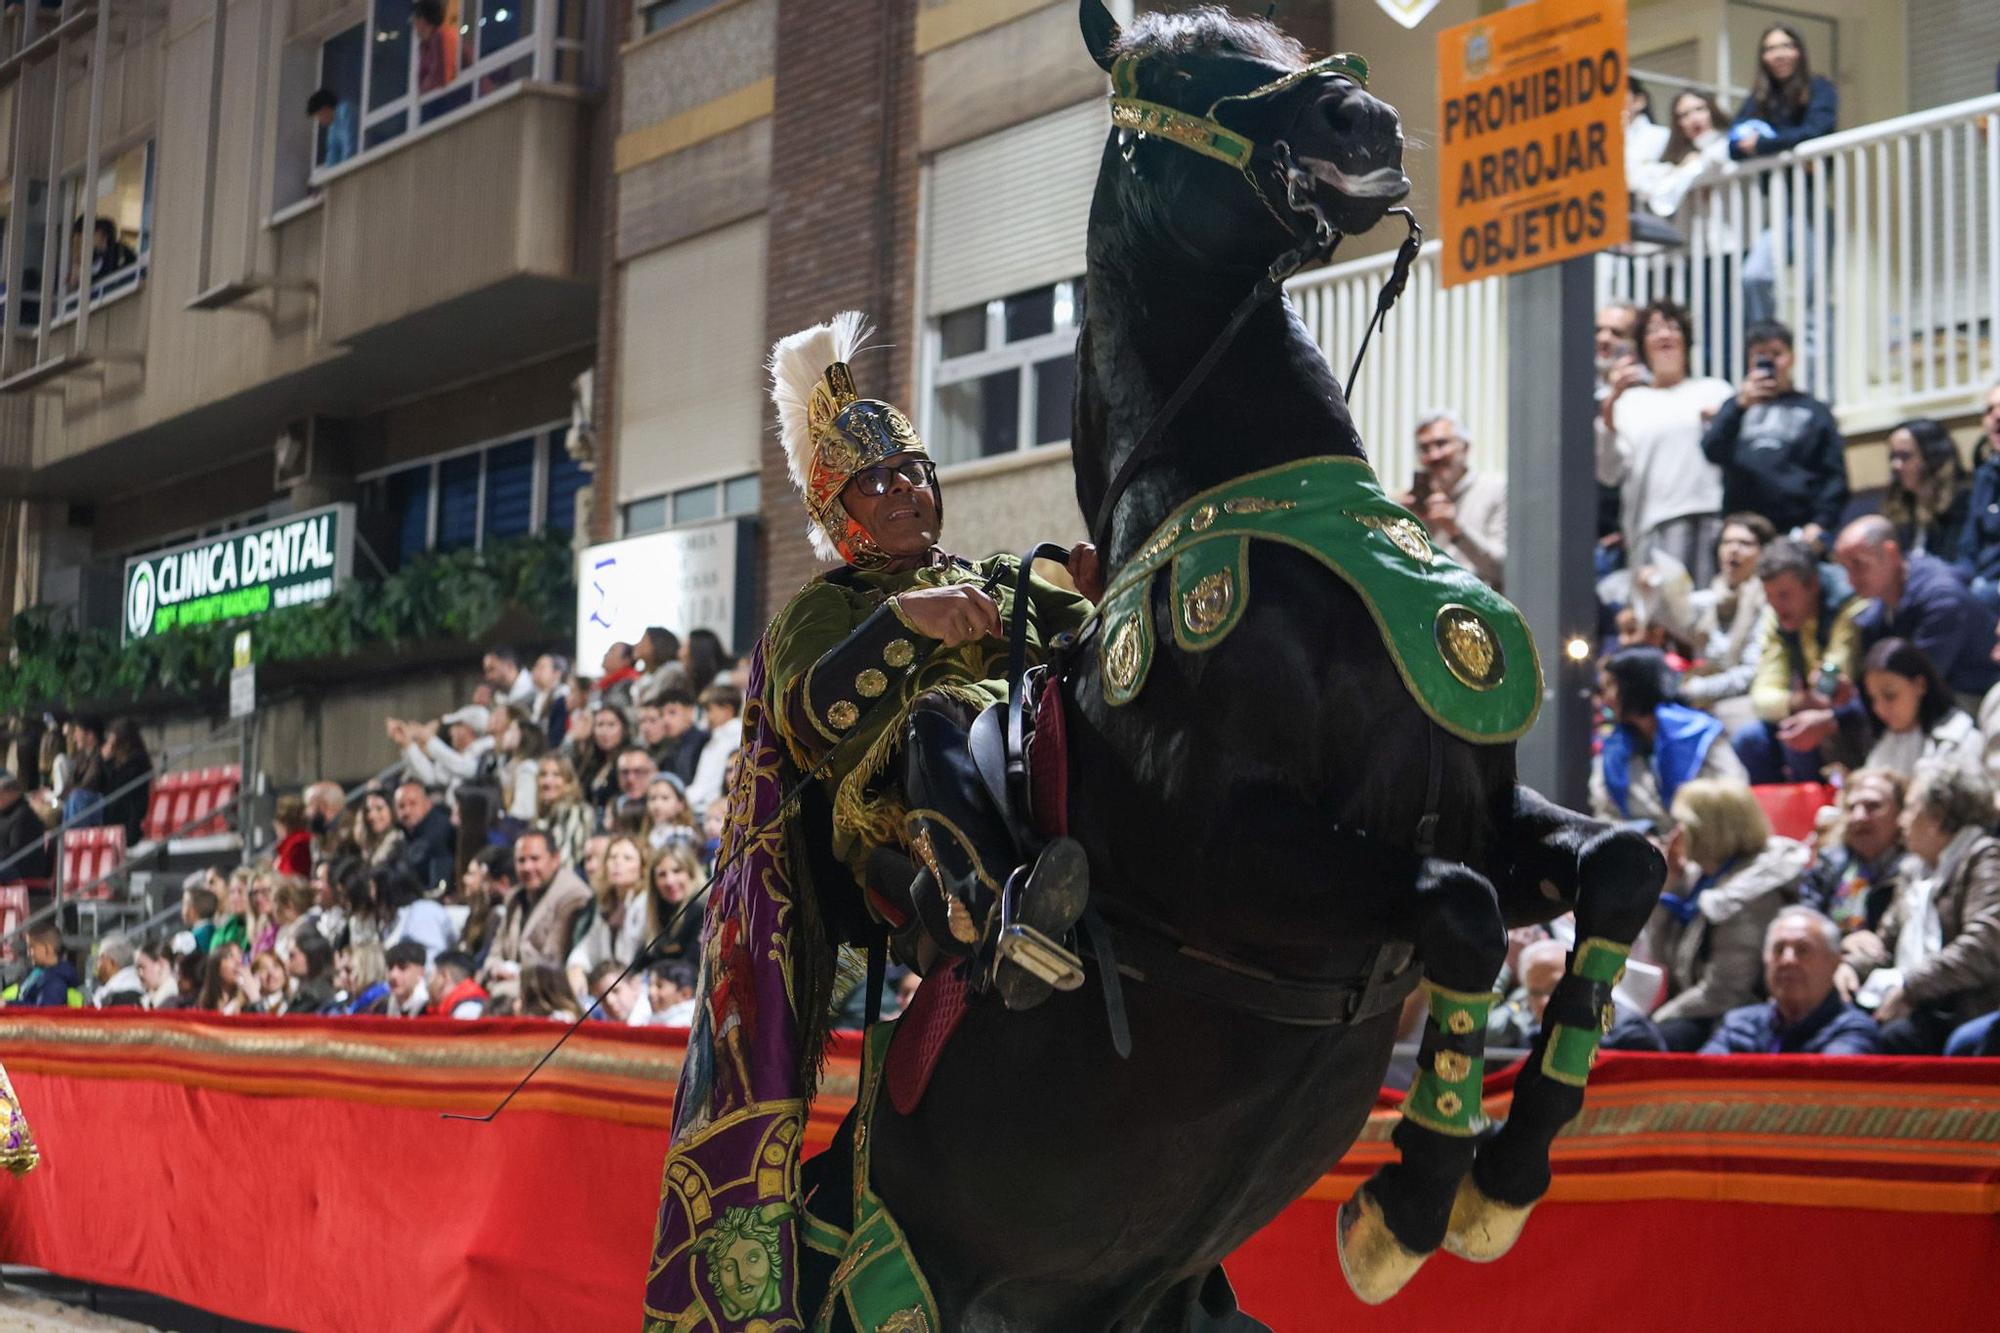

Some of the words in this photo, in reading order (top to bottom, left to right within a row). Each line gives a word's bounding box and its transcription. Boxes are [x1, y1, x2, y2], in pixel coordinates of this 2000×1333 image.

[1444, 49, 1621, 145] PROHIBIDO
[1457, 122, 1608, 206] ARROJAR
[1460, 191, 1607, 272] OBJETOS
[157, 541, 238, 605] CLINICA
[241, 515, 334, 586] DENTAL
